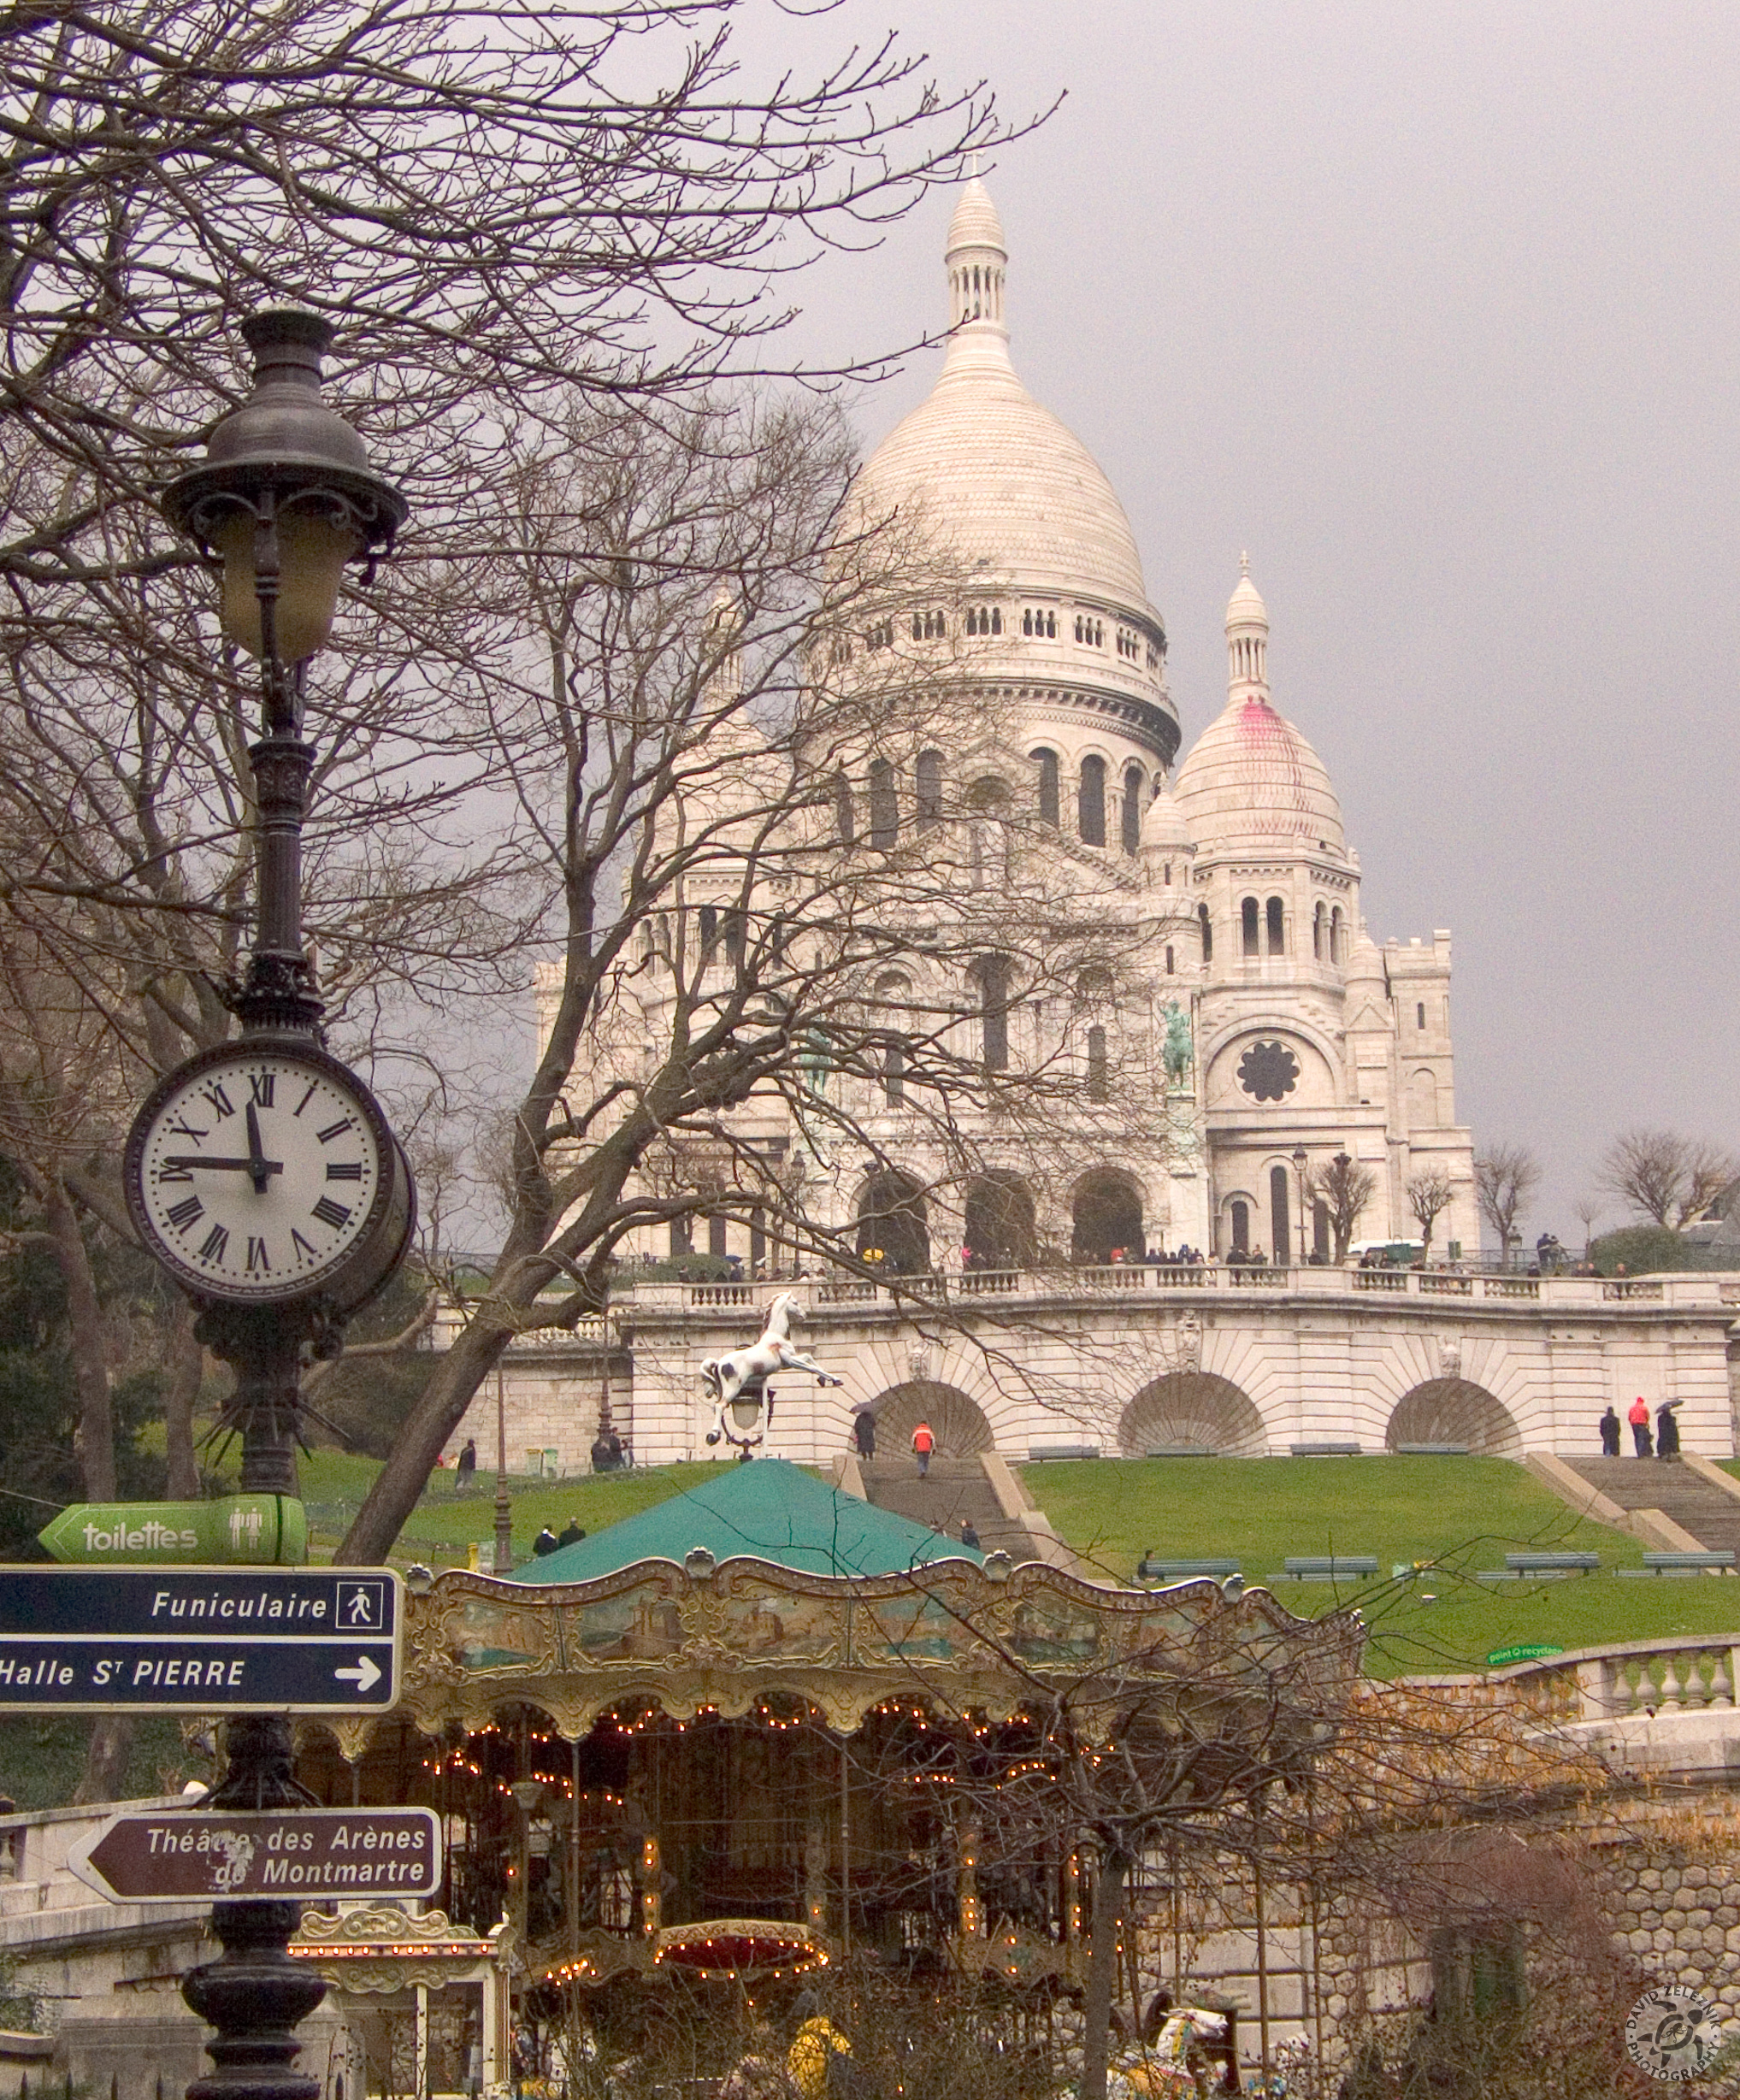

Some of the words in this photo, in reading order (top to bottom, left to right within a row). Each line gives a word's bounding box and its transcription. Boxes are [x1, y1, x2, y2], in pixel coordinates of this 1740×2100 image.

[203, 1083, 235, 1122] XI
[248, 1074, 276, 1107] XII
[293, 1085, 316, 1117] I
[170, 1116, 209, 1147] X
[316, 1118, 352, 1144] II
[327, 1162, 363, 1182] III
[166, 1195, 205, 1236] VIII
[310, 1195, 352, 1230] IIII
[198, 1223, 229, 1265] VII
[245, 1236, 271, 1271] VI
[291, 1228, 317, 1262] V
[83, 1520, 198, 1551] toilettes
[151, 1591, 327, 1619] Funiculaire
[1489, 1650, 1512, 1663] point
[0, 1660, 74, 1685] Halle
[133, 1661, 245, 1686] PIERRE
[268, 1826, 314, 1851] des
[331, 1825, 426, 1851] Arènes
[262, 1858, 425, 1885] Montmartre
